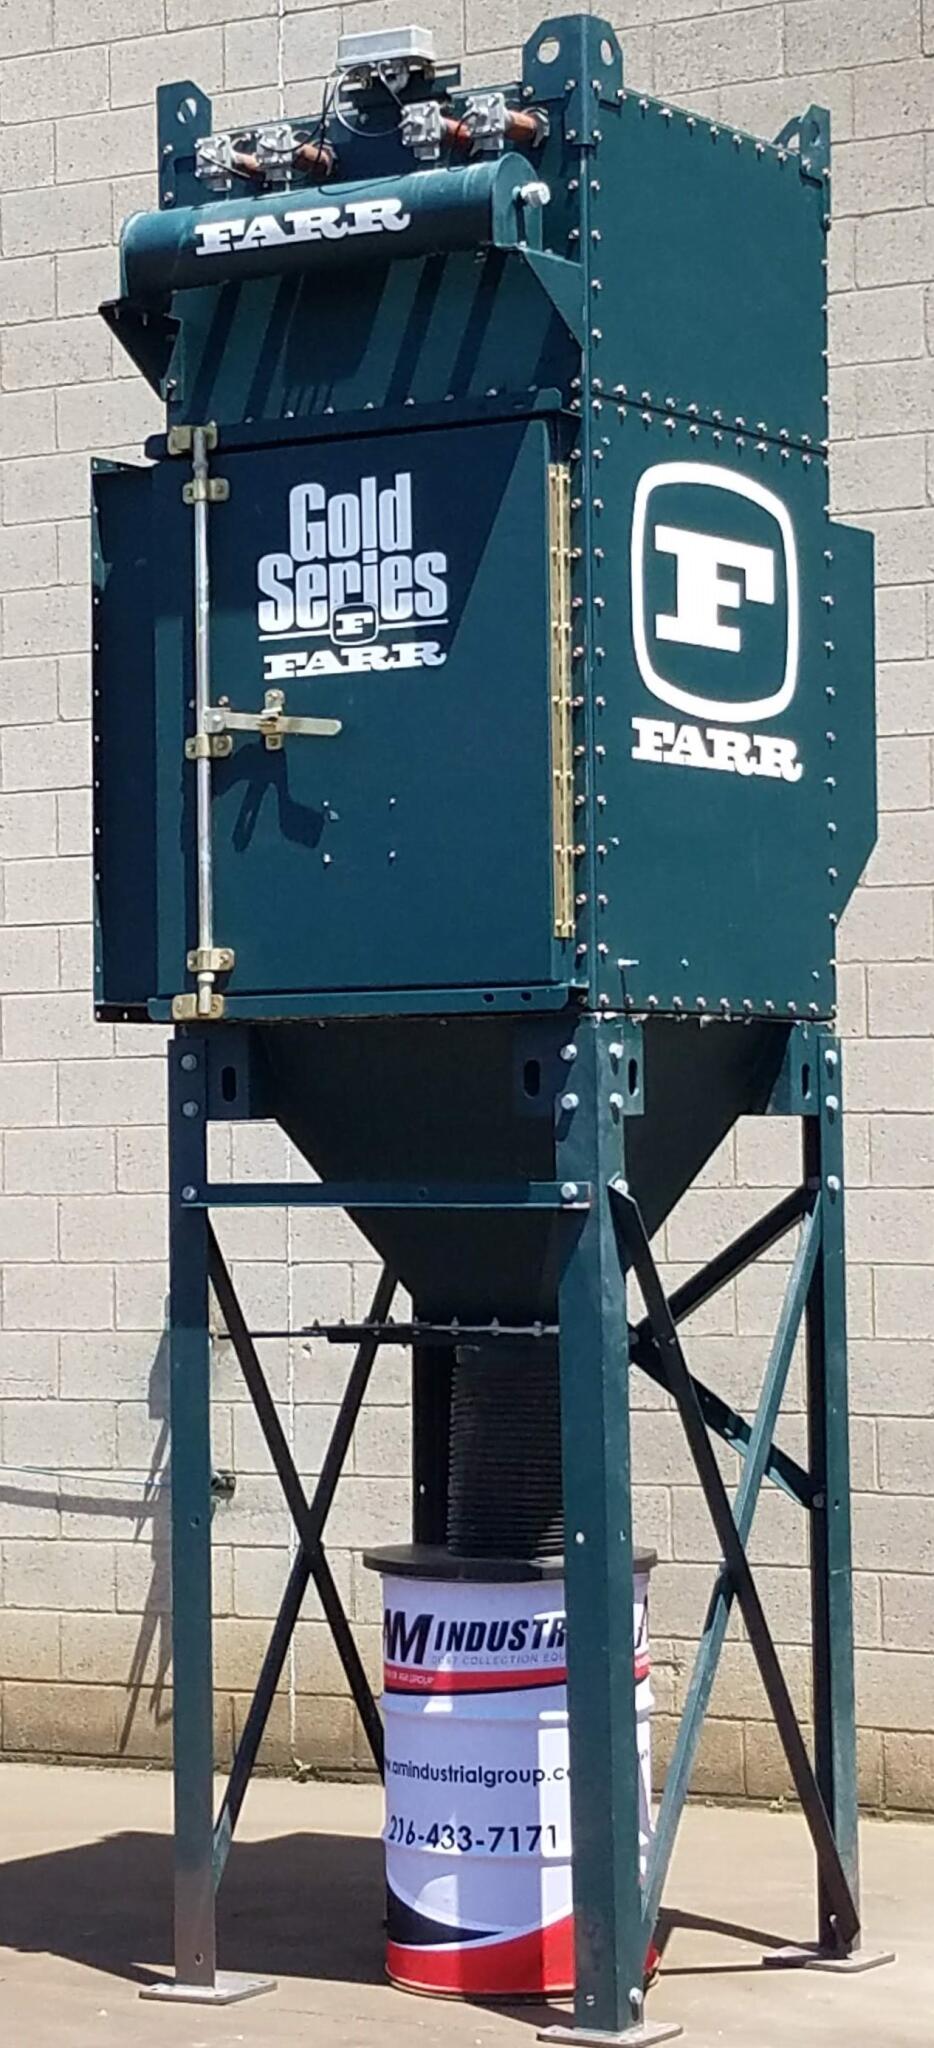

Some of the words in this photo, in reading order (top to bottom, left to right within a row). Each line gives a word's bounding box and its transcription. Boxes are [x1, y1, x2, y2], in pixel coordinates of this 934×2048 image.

[195, 199, 410, 256] FARR
[289, 472, 412, 562] Gold
[257, 549, 448, 632] Series
[655, 524, 774, 652] F
[335, 611, 374, 636] F
[263, 641, 447, 680] FARR
[631, 716, 803, 783] FARR
[434, 1619, 566, 1652] INDUSTR
[462, 1653, 538, 1666] COLLECTION
[388, 1815, 556, 1852] 216-433-7171
